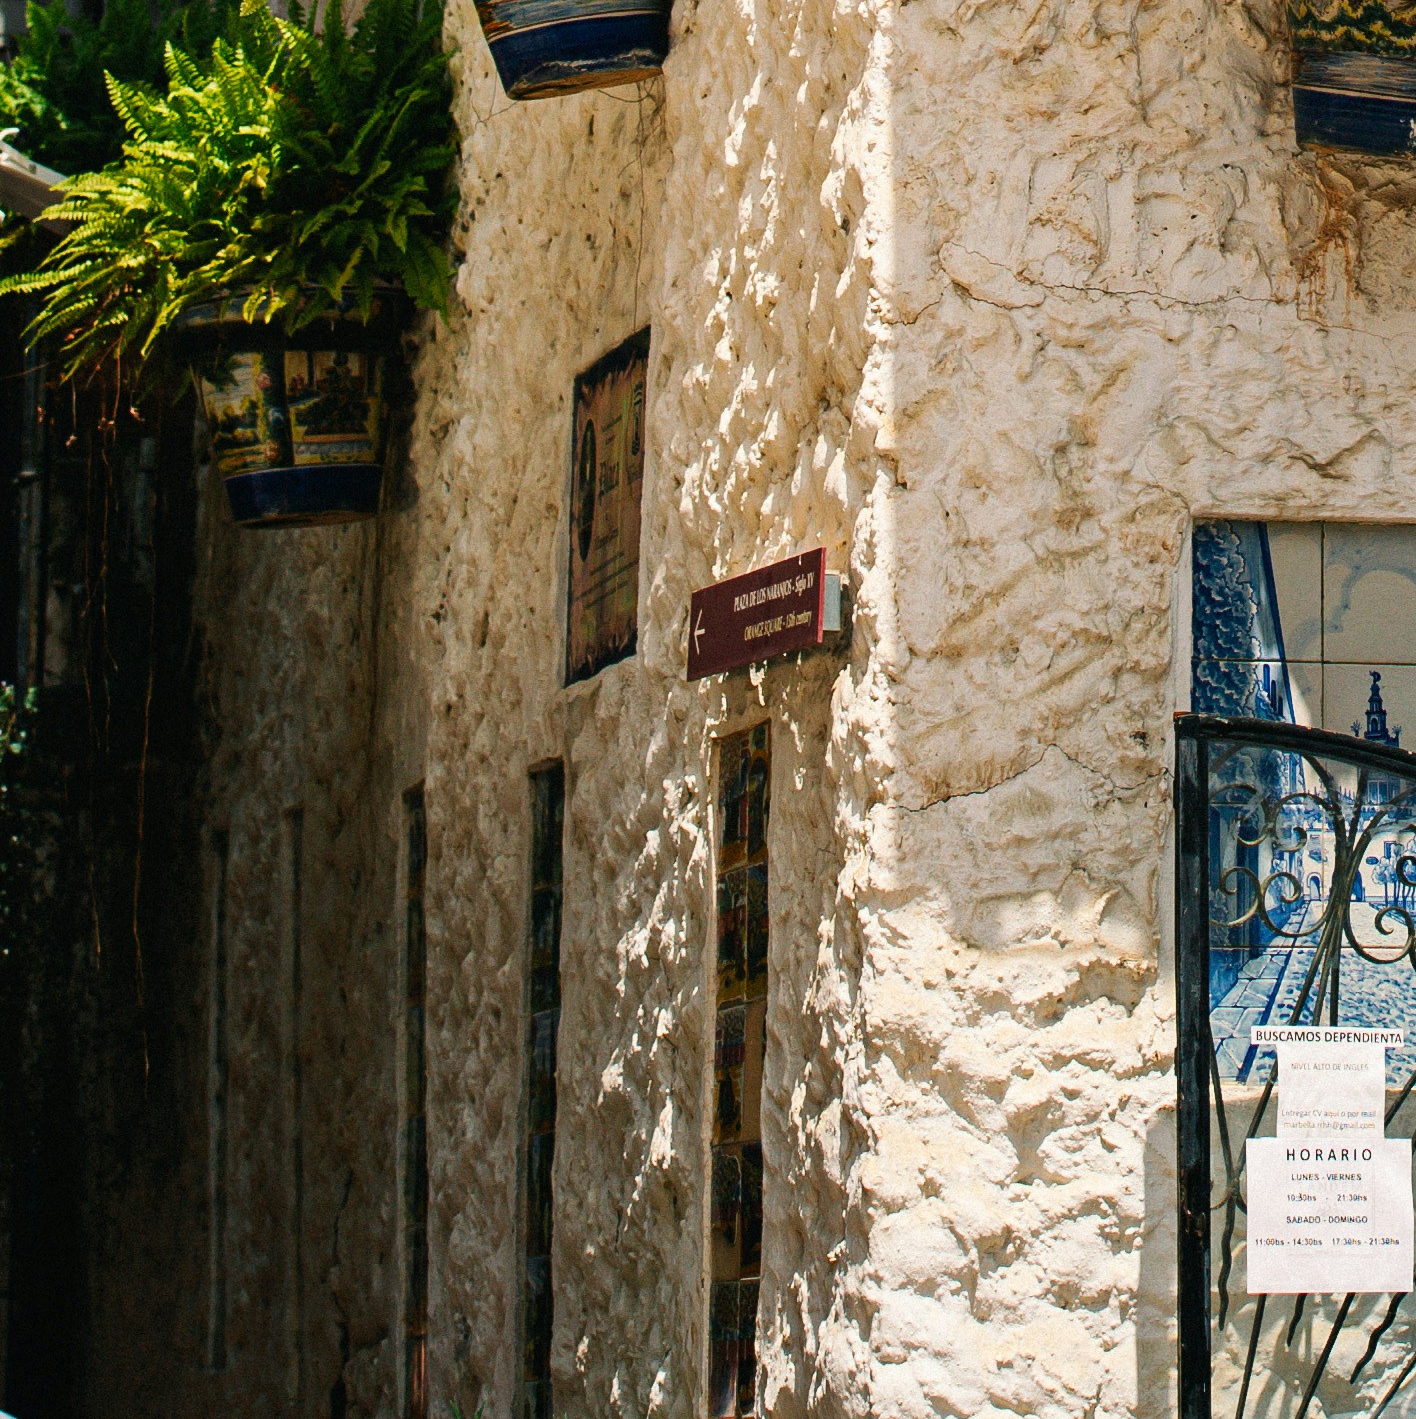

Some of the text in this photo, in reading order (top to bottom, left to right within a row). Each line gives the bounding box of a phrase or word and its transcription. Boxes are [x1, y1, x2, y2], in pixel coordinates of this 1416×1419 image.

[733, 593, 749, 613] PLAZA
[756, 587, 767, 605] LOS
[766, 578, 793, 600] NARANJOS
[1255, 1030, 1403, 1044] BUSCAMOS DEPENDIENTA
[1313, 1063, 1331, 1071] ALTO
[1332, 1063, 1342, 1071] DE
[1286, 1148, 1373, 1161] HORARIO
[1291, 1173, 1320, 1181] LUNES
[1326, 1173, 1363, 1181] VIERNES
[1328, 1216, 1369, 1224] DOMINGO
